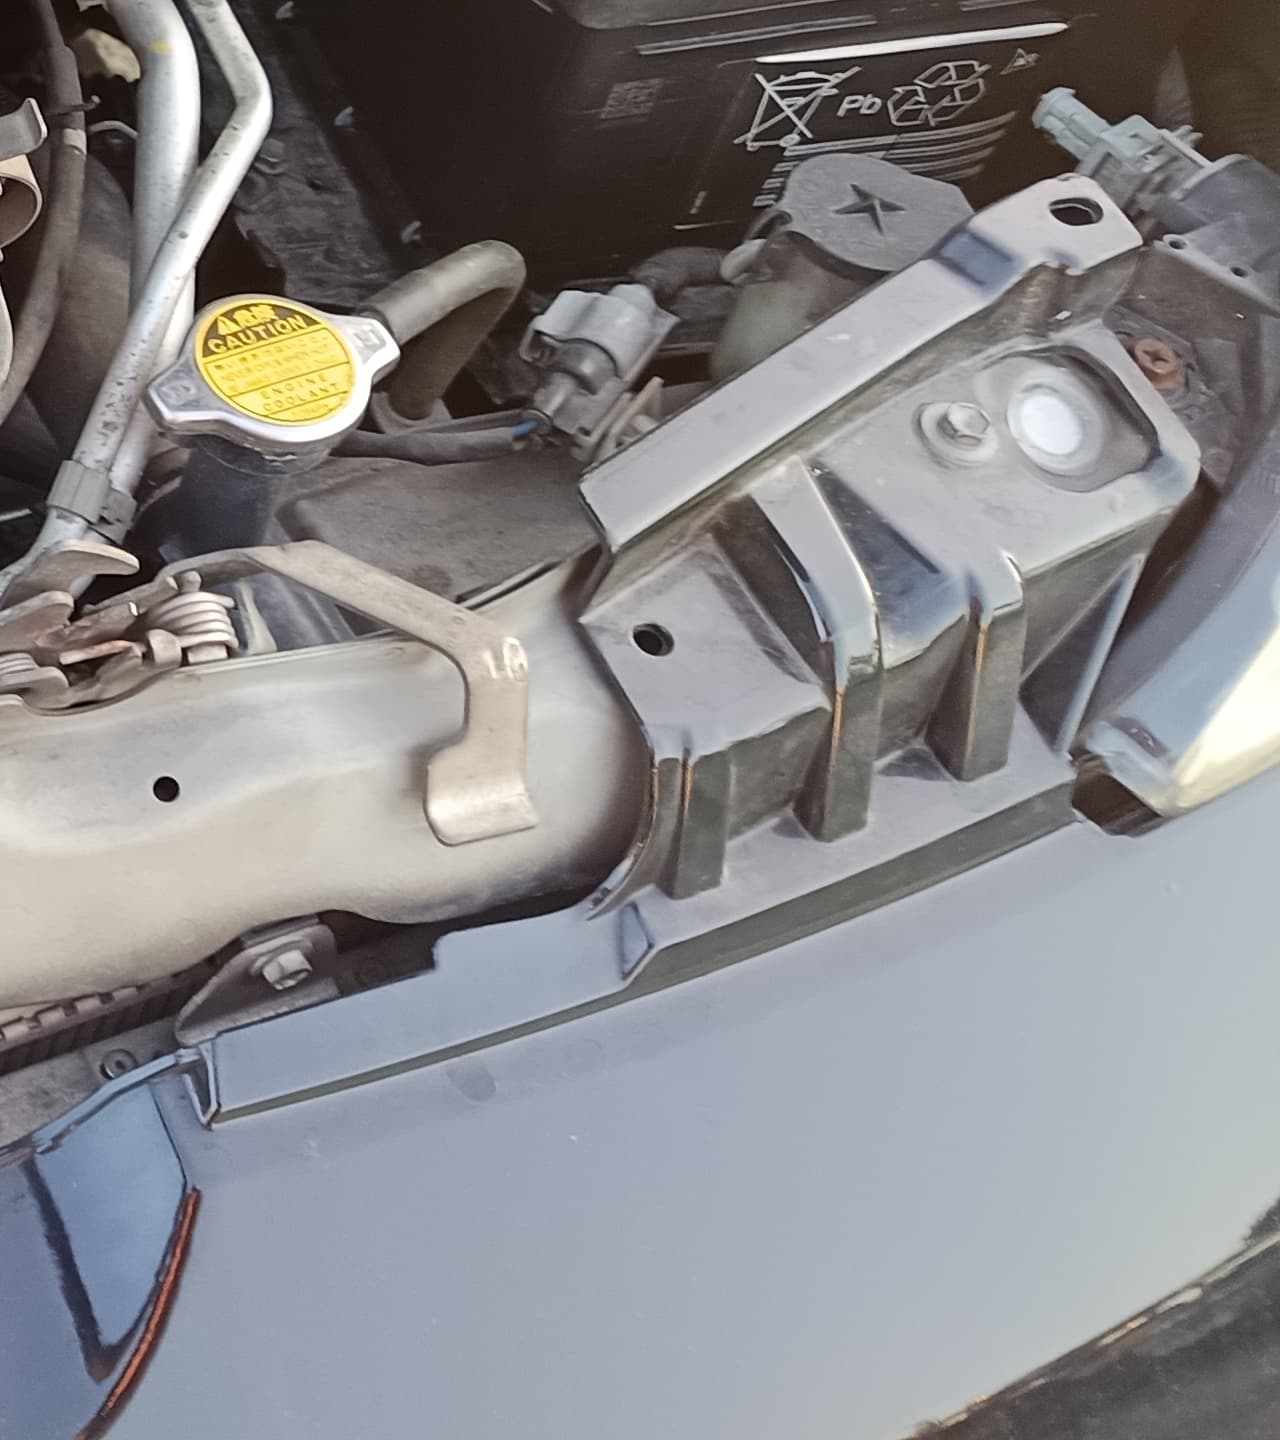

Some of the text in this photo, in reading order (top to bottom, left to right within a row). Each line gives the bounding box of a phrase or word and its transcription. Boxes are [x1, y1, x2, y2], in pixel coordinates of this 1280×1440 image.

[835, 92, 882, 117] Pb
[207, 314, 308, 353] CAUTION
[259, 373, 329, 399] ENGINE
[262, 382, 338, 411] COOLANT
